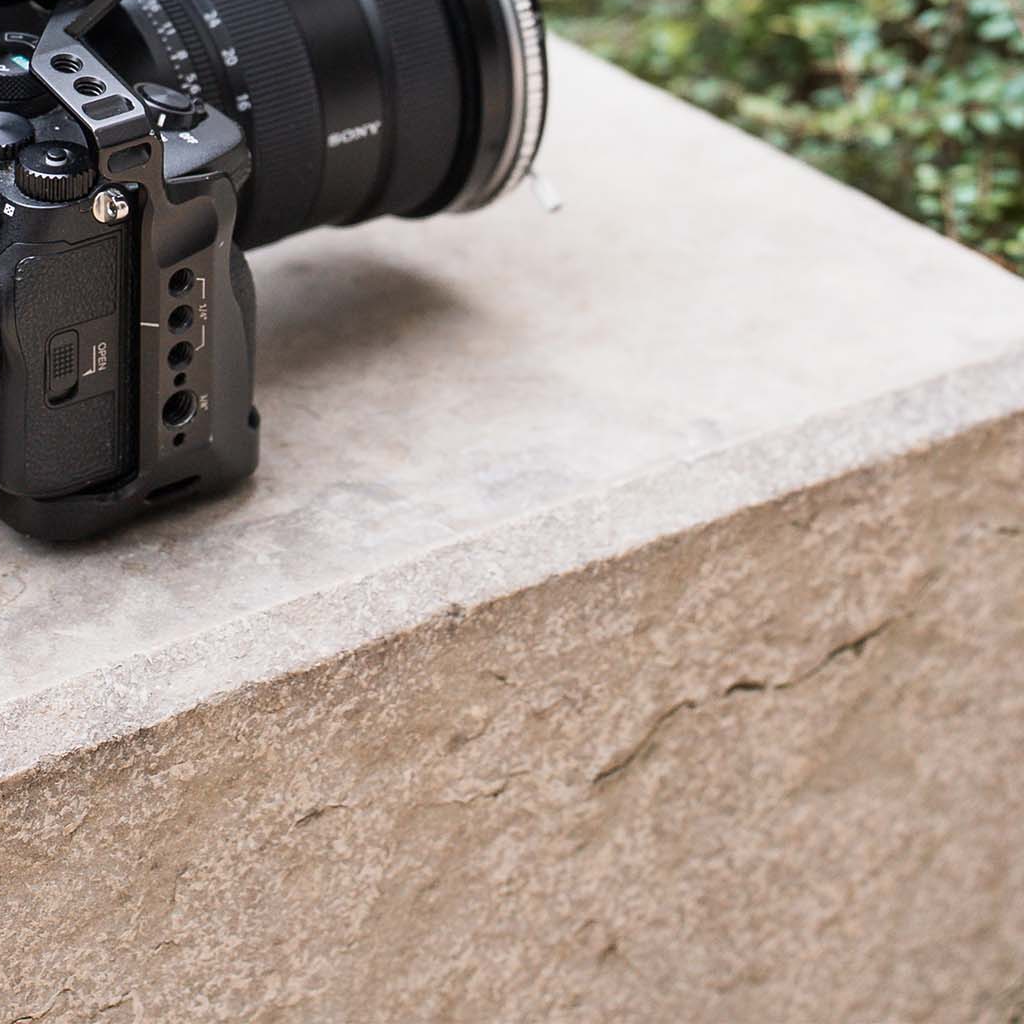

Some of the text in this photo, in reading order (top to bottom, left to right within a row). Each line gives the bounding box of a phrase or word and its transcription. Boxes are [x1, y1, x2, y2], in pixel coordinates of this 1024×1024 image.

[221, 47, 239, 67] 20
[235, 93, 252, 112] 16
[327, 119, 382, 148] SONY
[97, 341, 108, 372] OPEN
